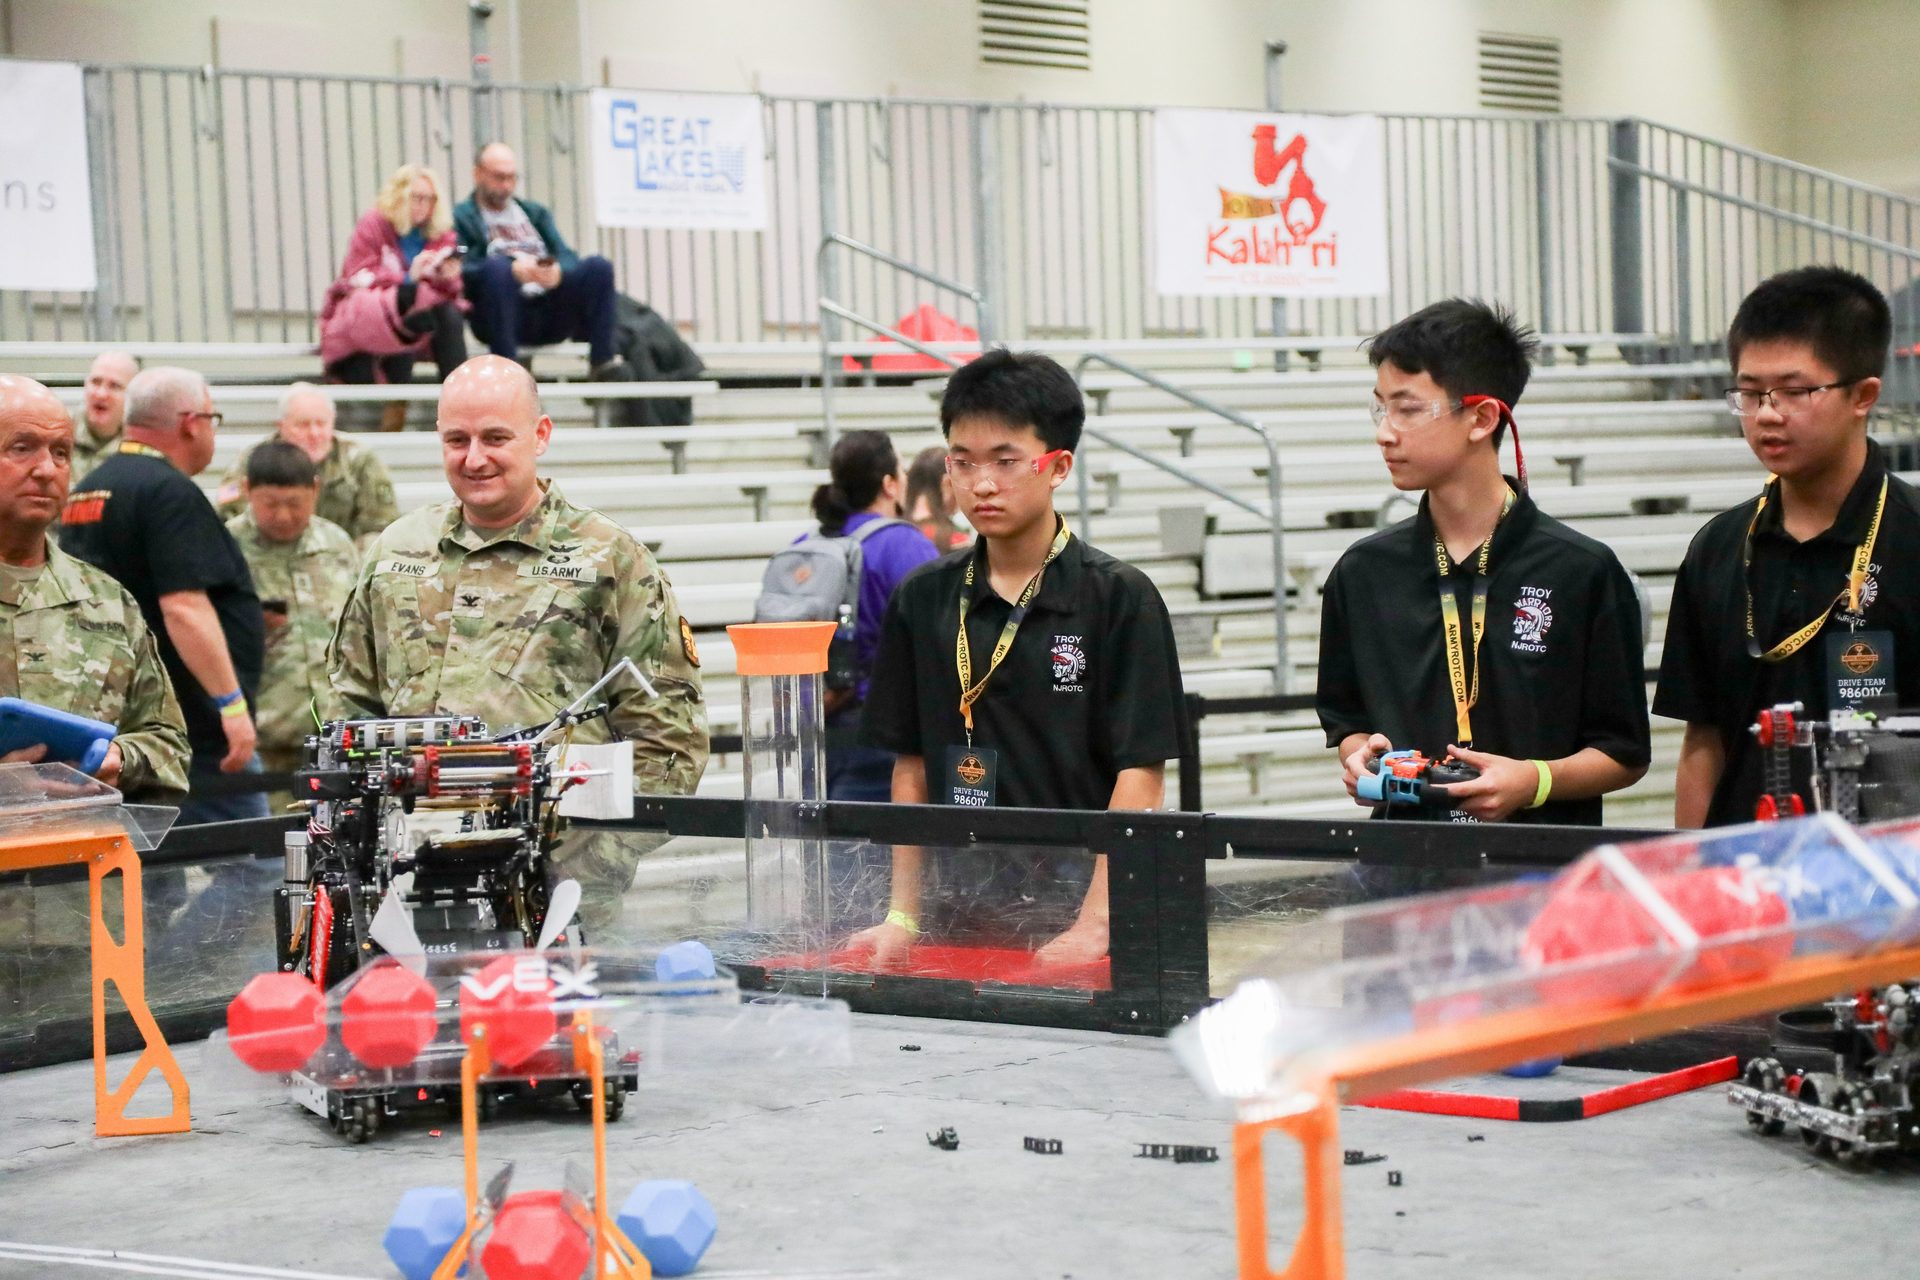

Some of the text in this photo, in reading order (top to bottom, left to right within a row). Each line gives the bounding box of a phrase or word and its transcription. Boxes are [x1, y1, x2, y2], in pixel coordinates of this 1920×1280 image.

[611, 100, 711, 148] GREAT
[635, 147, 714, 190] LAKES
[391, 562, 427, 576] EVANS
[1520, 586, 1552, 599] TROY
[1054, 635, 1083, 644] TROY
[1511, 640, 1547, 653] NJROTC
[1449, 622, 1465, 703] ARMYROTC.COM
[1052, 684, 1083, 692] NJROTC
[1838, 678, 1886, 687] DRIVE TEAM
[1839, 687, 1883, 698] 98601Y
[953, 786, 989, 798] DRIVE TEAM
[954, 794, 987, 807] 98601Y
[459, 957, 600, 1001] VEX
